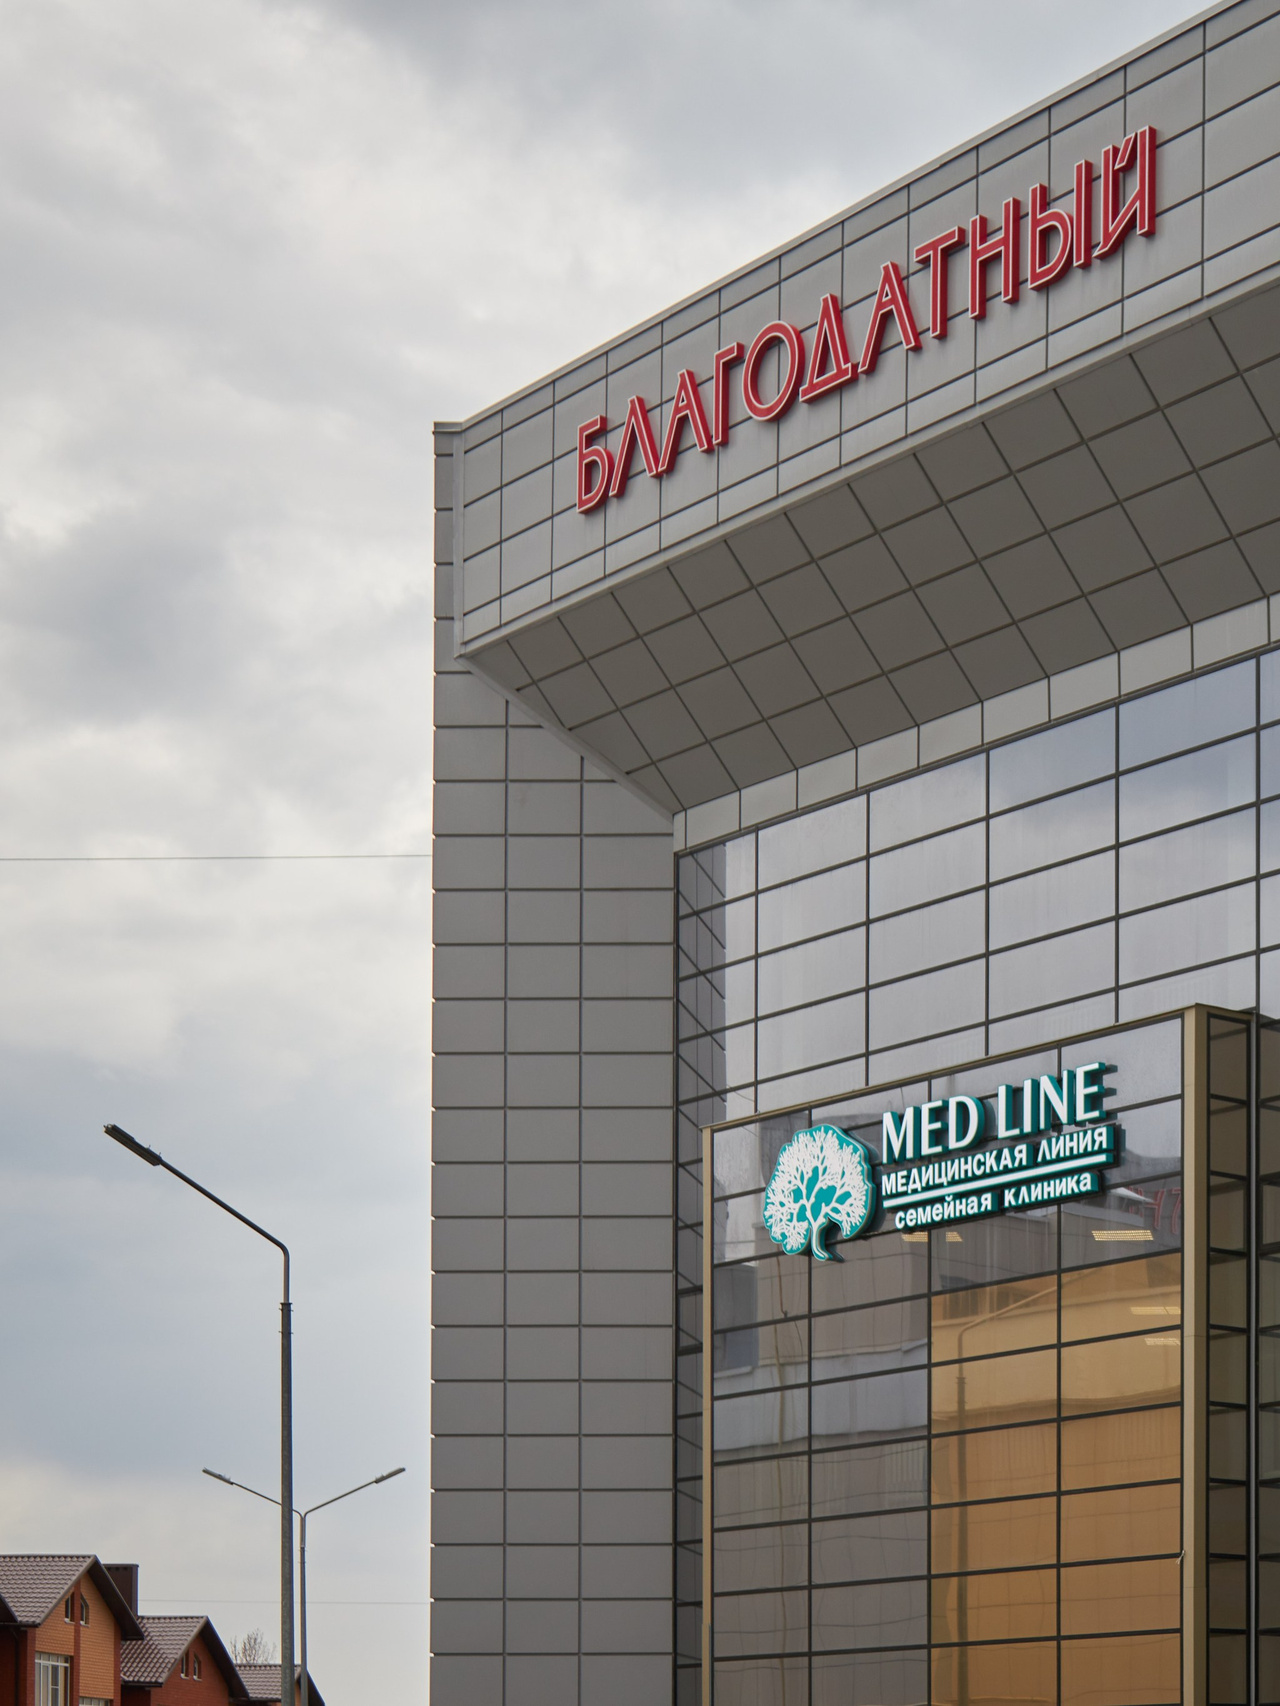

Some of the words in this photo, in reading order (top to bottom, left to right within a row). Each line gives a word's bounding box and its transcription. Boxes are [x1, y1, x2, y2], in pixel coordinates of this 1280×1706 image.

[576, 125, 1158, 515] БЛАГОДАТНЫЙ
[882, 1095, 985, 1163] MED
[997, 1061, 1109, 1137] LINE
[881, 1143, 1034, 1196] МЕДИЦИНСКАЯ
[1037, 1125, 1113, 1163] ЛИНИЯ
[895, 1191, 996, 1230] семейная
[1003, 1171, 1096, 1210] клиника
